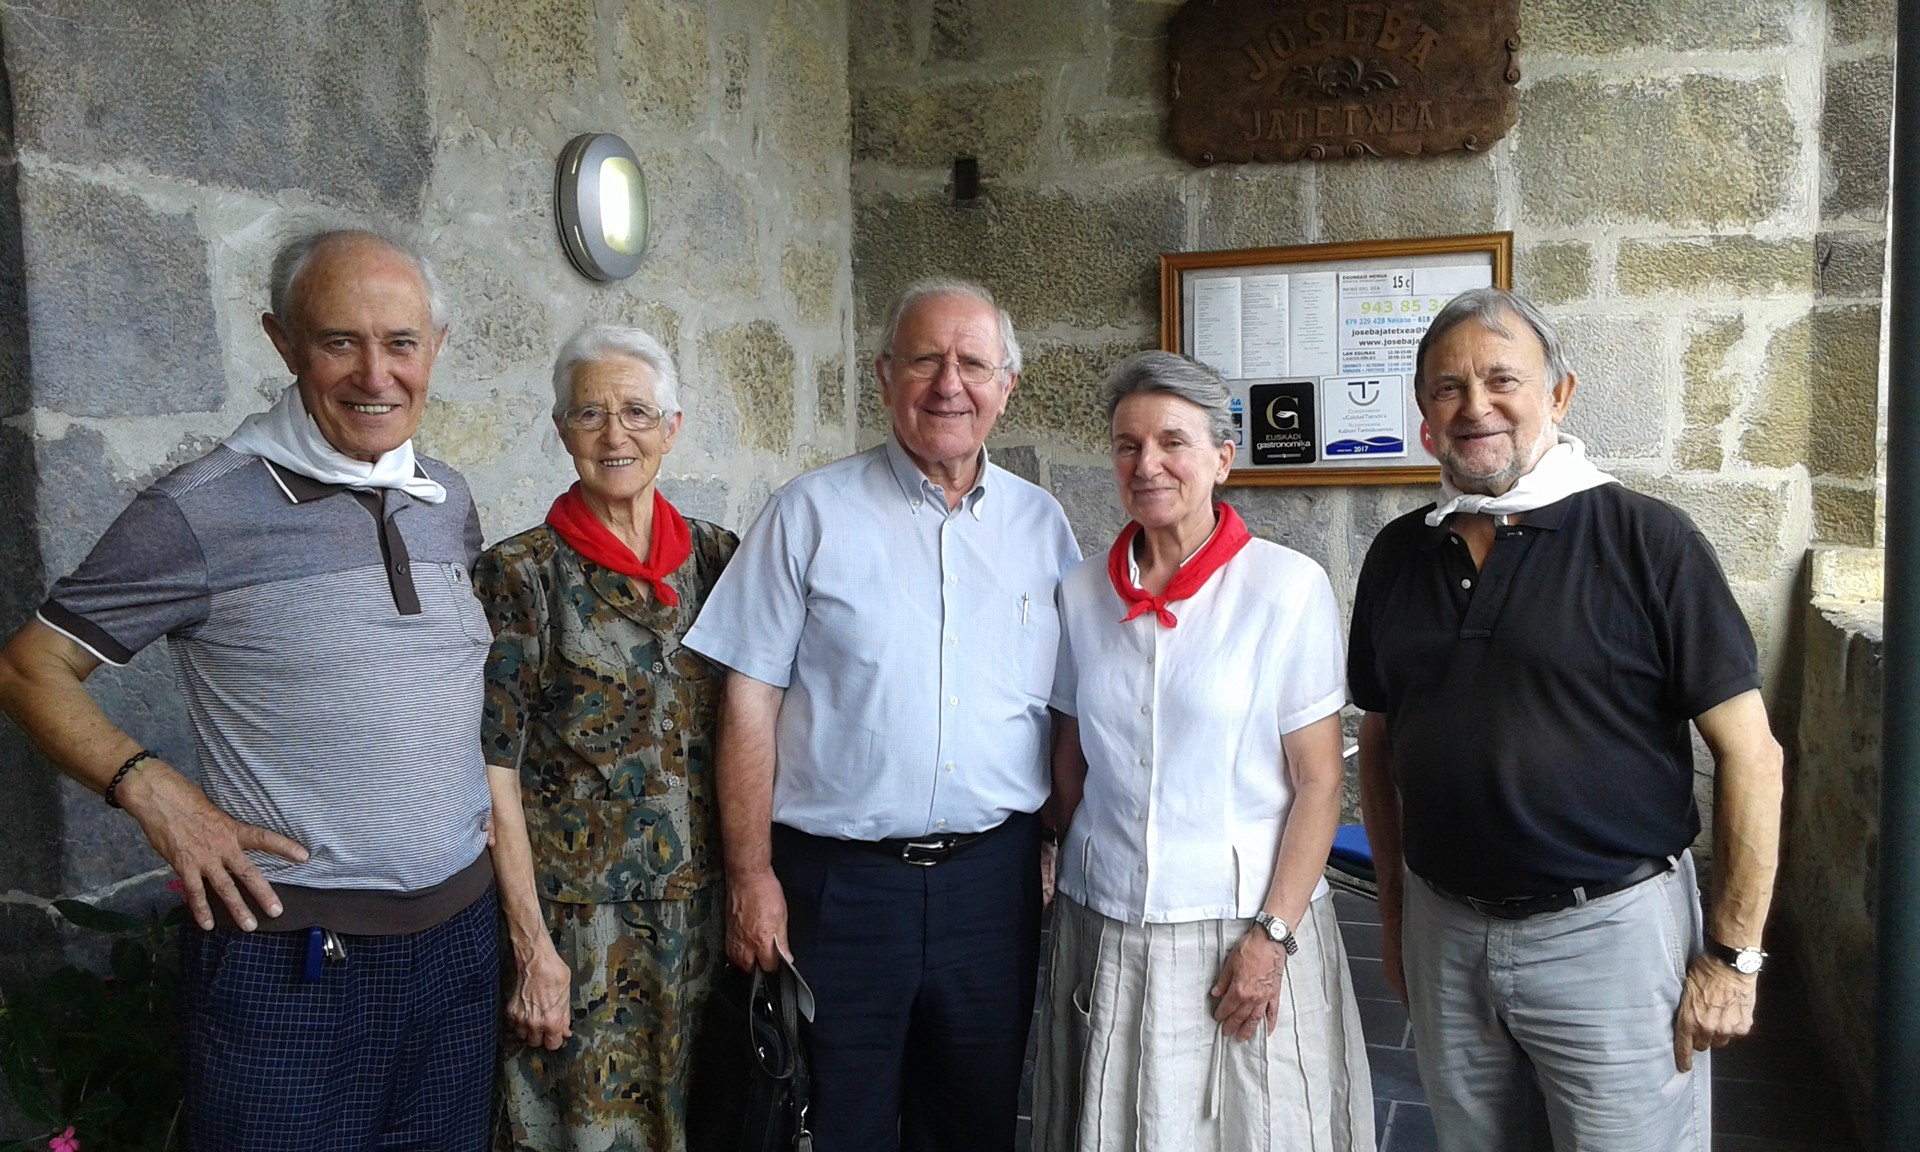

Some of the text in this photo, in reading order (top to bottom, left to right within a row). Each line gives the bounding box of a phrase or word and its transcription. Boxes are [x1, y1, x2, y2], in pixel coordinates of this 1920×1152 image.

[1244, 5, 1440, 81] JOSEBA
[1244, 101, 1434, 141] JATETXEA
[1361, 301, 1393, 314] 943
[1400, 300, 1421, 313] 85
[1265, 433, 1302, 441] EUSKADI
[1256, 440, 1311, 450] gastronomika
